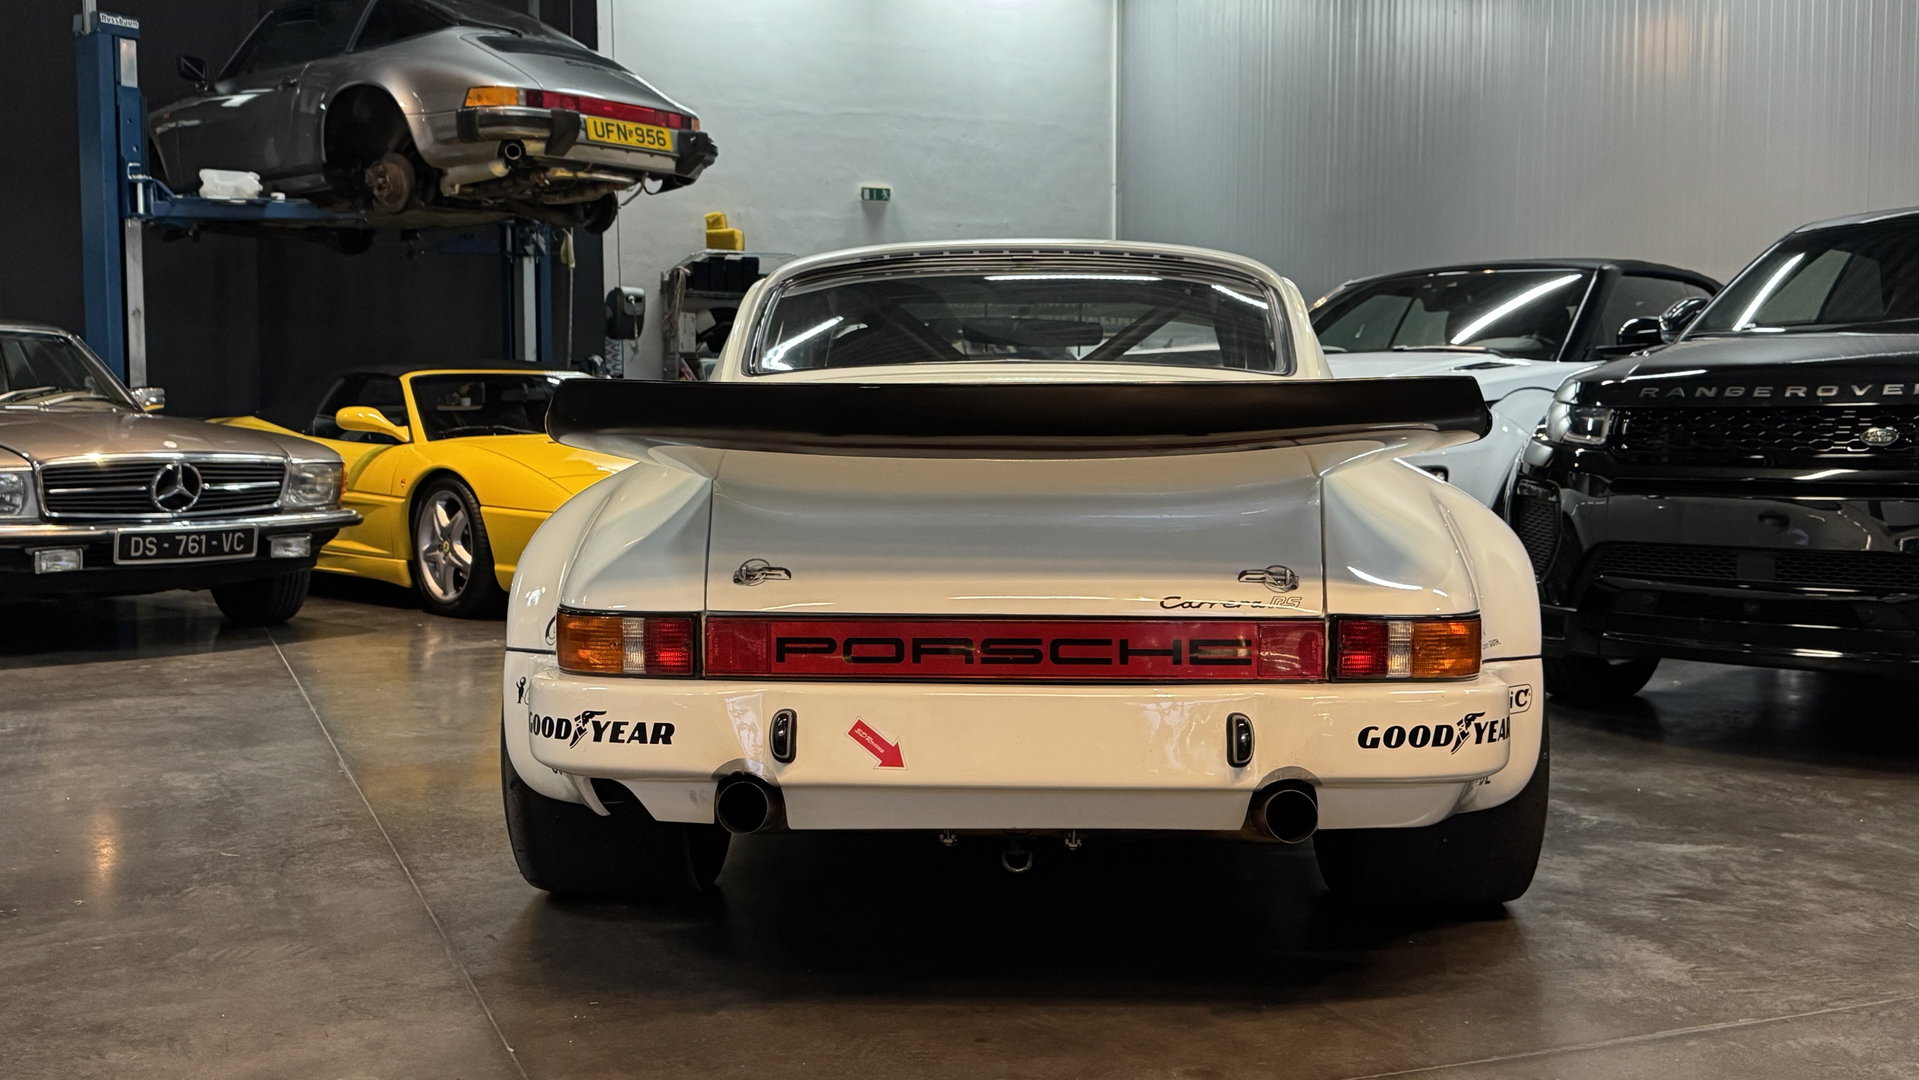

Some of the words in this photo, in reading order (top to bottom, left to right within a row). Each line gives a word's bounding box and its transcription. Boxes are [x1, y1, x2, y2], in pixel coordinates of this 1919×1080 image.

[593, 120, 628, 142] UFN
[634, 127, 667, 147] 956
[1639, 386, 1775, 398] RANGE
[1160, 596, 1265, 610] Carrera
[1269, 595, 1303, 609] RS
[775, 636, 1252, 666] PORSCHE
